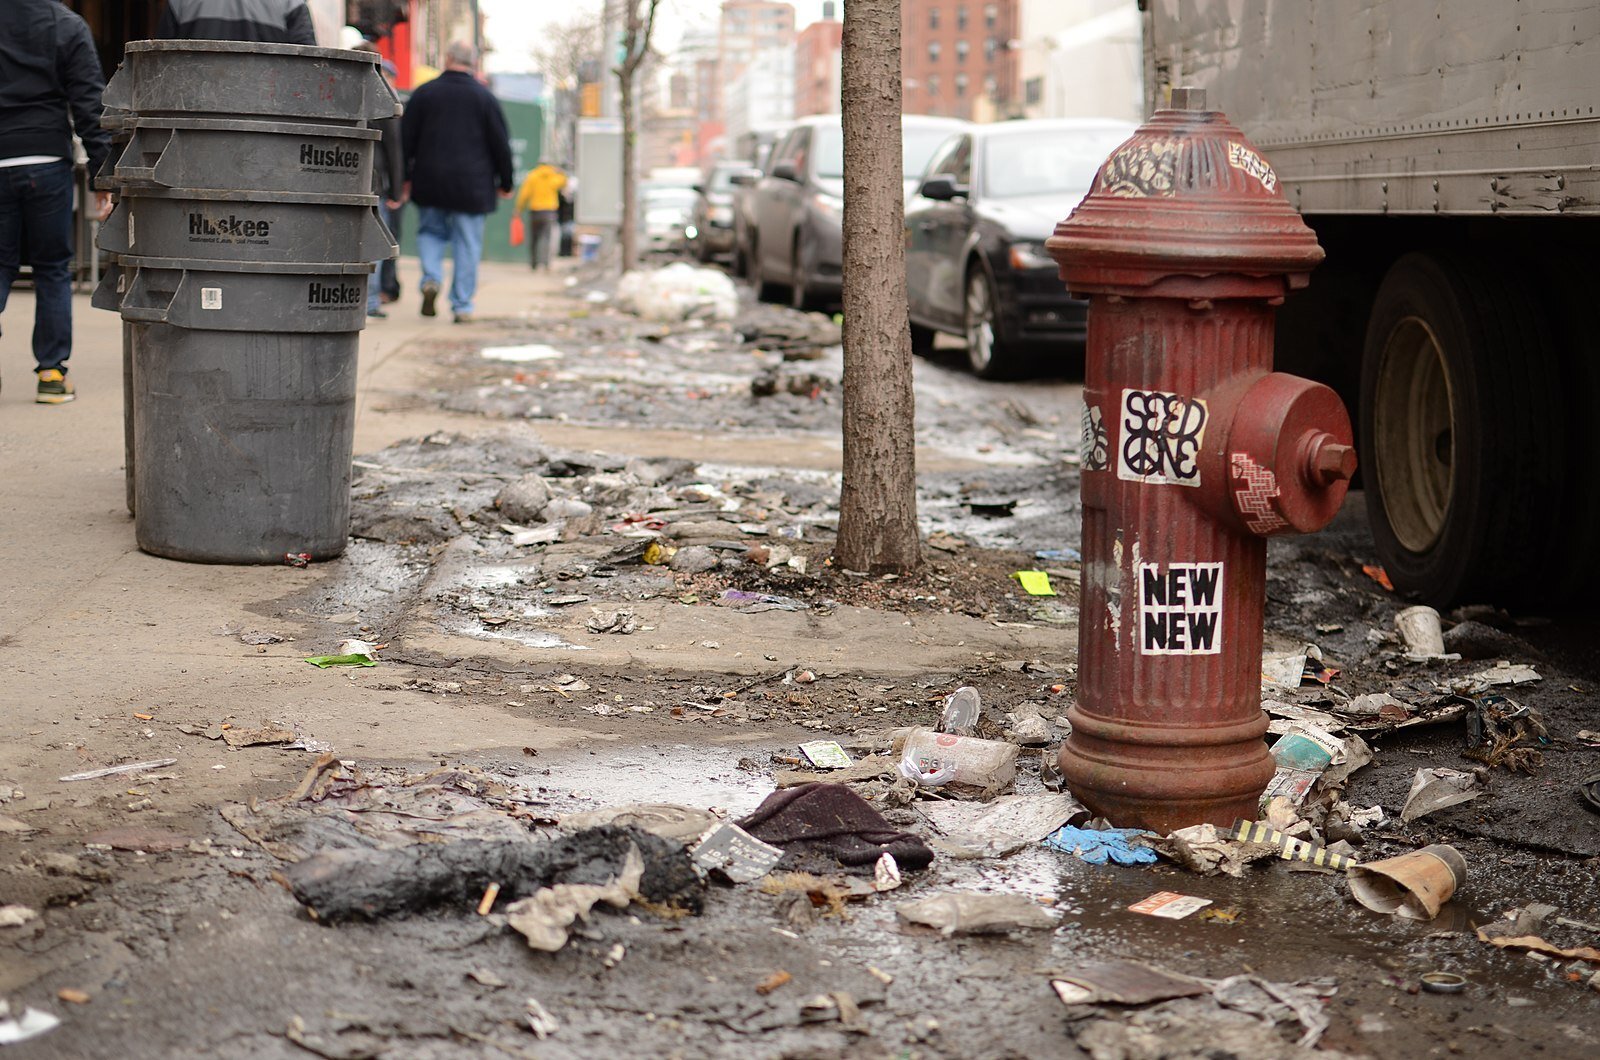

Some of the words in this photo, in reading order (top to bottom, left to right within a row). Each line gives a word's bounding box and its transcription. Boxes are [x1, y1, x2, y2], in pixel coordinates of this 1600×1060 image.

[300, 144, 359, 168] Huskee
[189, 213, 269, 237] Huskee
[308, 282, 360, 303] Huskee
[1142, 566, 1219, 606] NEW
[1144, 611, 1218, 650] NEW
